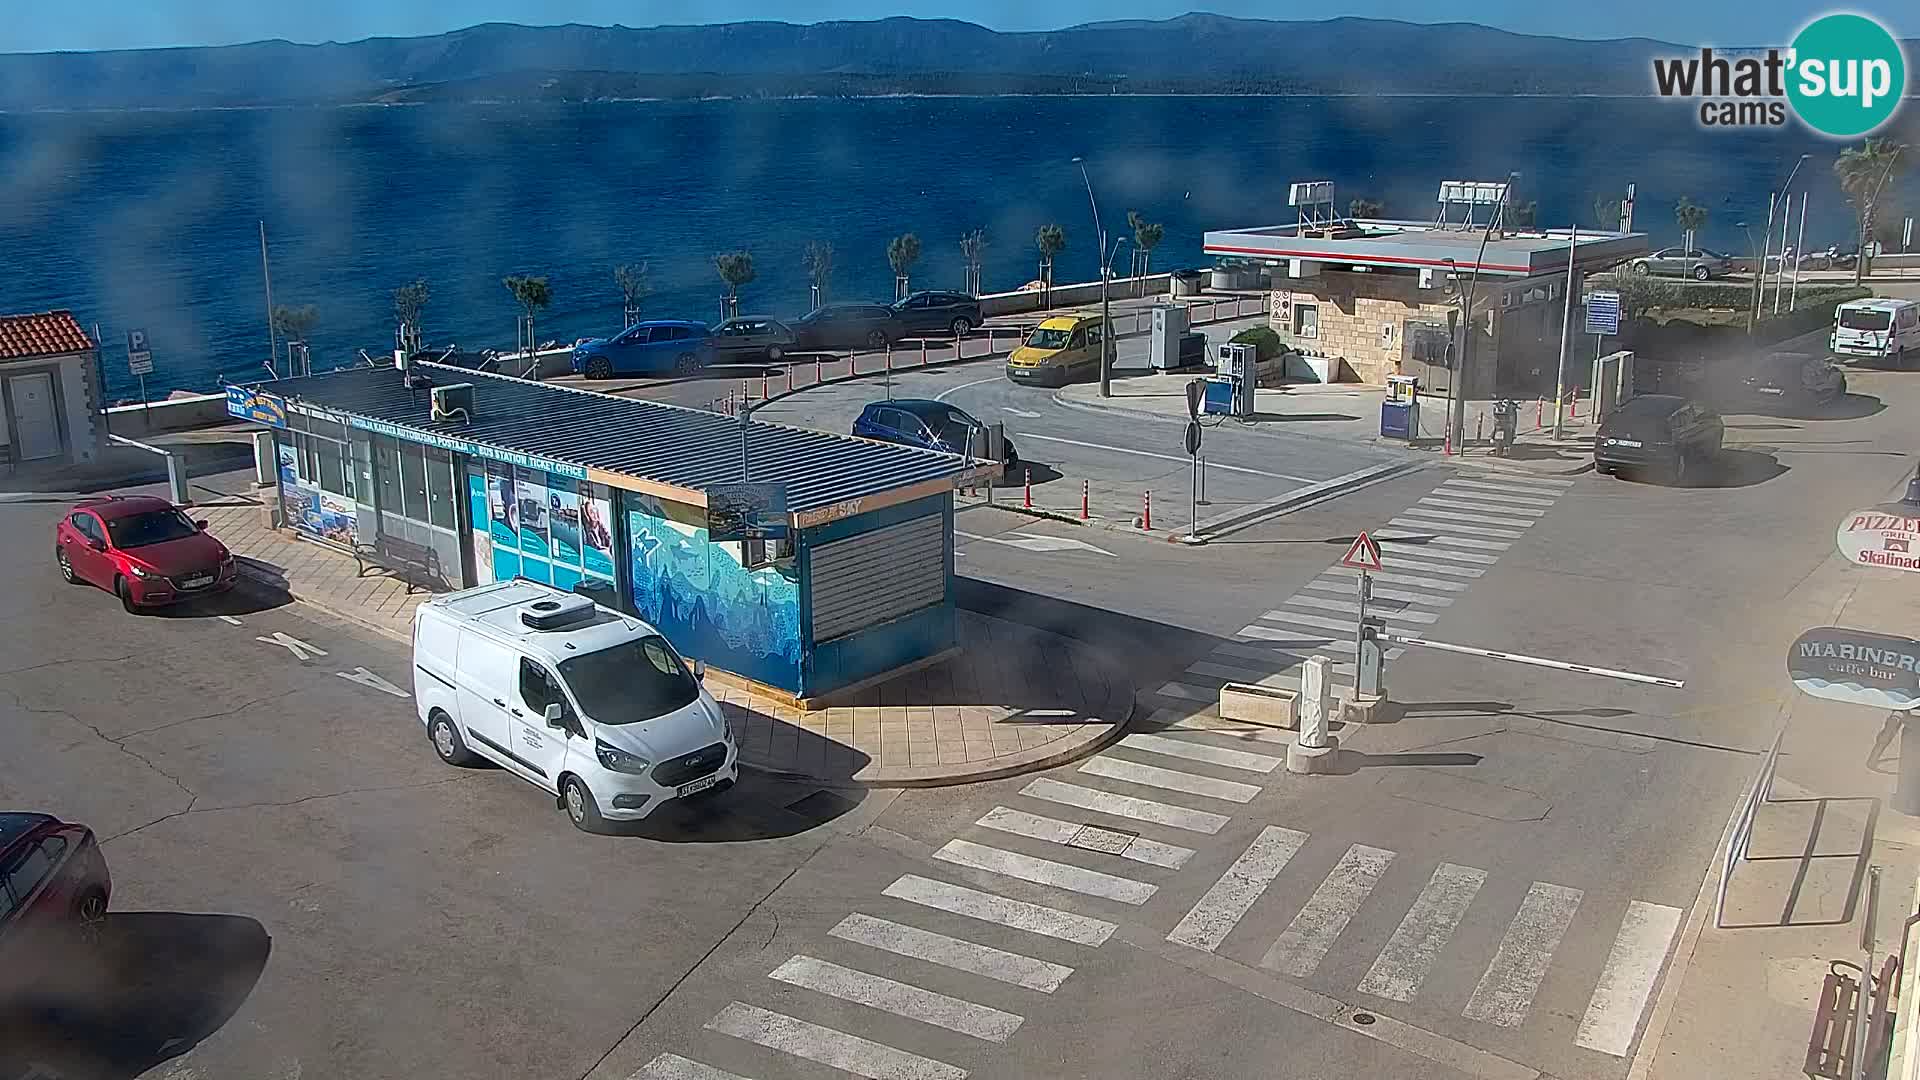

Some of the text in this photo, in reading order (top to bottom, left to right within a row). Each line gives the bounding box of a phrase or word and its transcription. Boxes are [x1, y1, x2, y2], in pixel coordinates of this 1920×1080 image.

[132, 331, 144, 349] P
[397, 427, 436, 443] AUTOBUSNA
[437, 437, 469, 451] POSTAJA
[479, 445, 494, 457] BUS
[495, 449, 527, 465] STATION
[528, 456, 554, 471] TICKET
[556, 463, 583, 478] OFFICE
[1880, 531, 1916, 540] GRILL
[1870, 666, 1896, 680] bar
